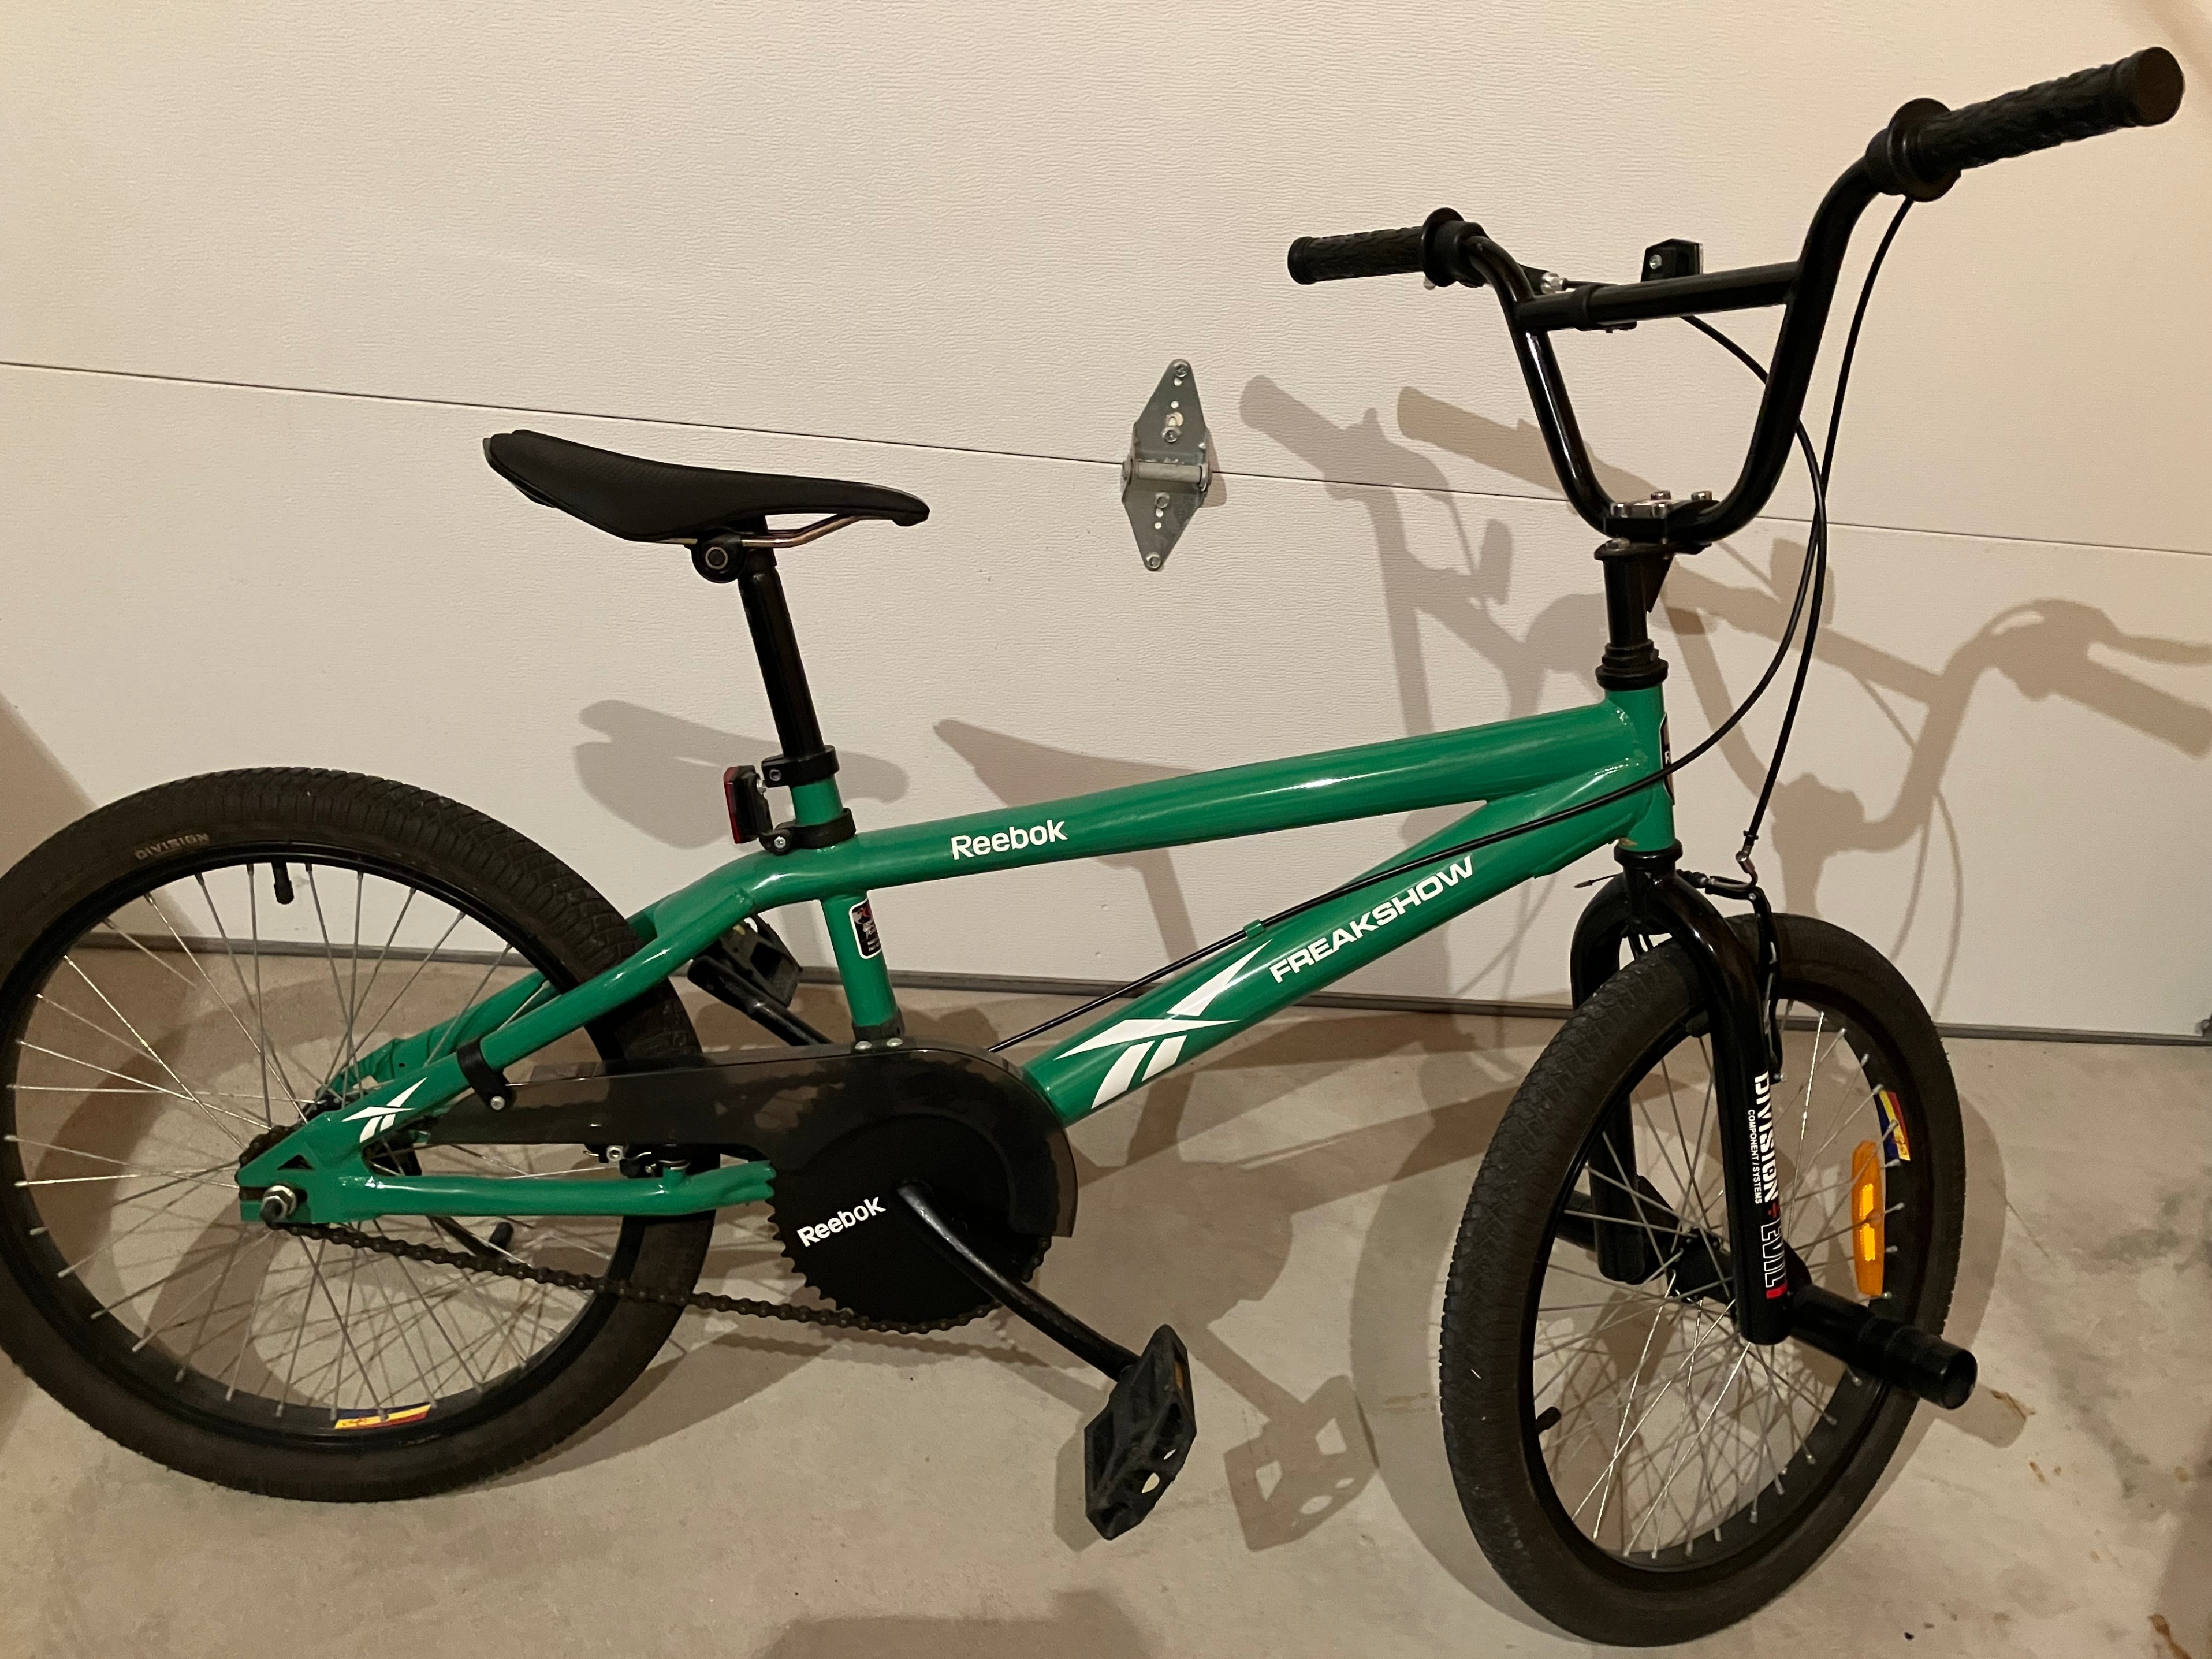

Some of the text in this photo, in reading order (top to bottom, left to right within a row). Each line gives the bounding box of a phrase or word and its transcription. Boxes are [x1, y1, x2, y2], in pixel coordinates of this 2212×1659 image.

[134, 833, 209, 860] DIVISION
[951, 819, 1068, 860] Reebok
[1269, 855, 1473, 983] FREAKSHOW
[1748, 1109, 1759, 1161] COMPONENT
[1755, 1070, 1779, 1203] DIVISION
[1752, 1166, 1762, 1204] SYSTEMS
[796, 1196, 887, 1247] Reebok
